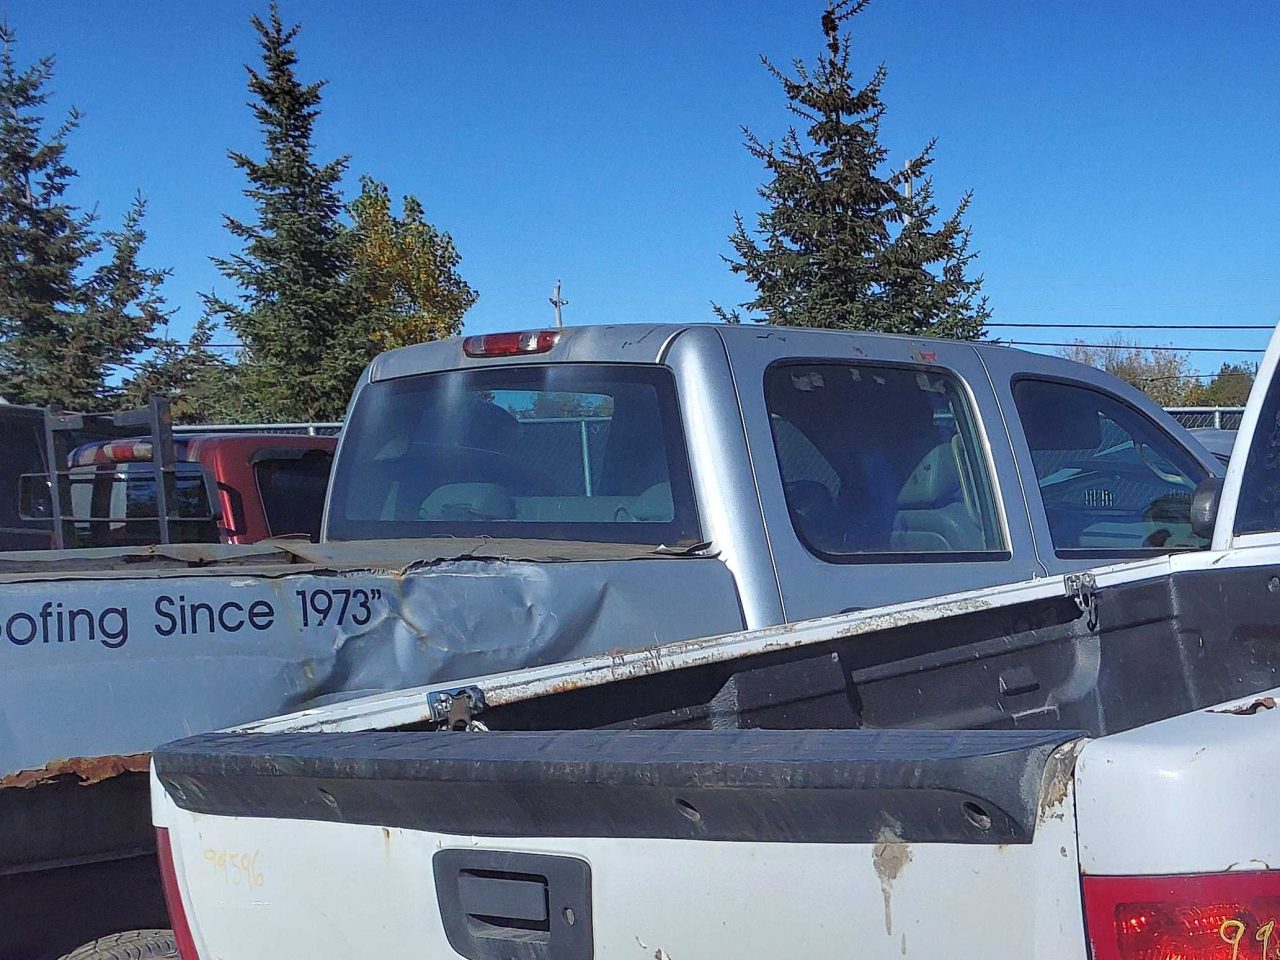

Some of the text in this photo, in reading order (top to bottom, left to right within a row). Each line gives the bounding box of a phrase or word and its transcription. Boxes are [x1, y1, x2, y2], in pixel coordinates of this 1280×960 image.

[0, 602, 128, 649] ofing
[155, 595, 275, 637] Since
[203, 848, 264, 891] 99596
